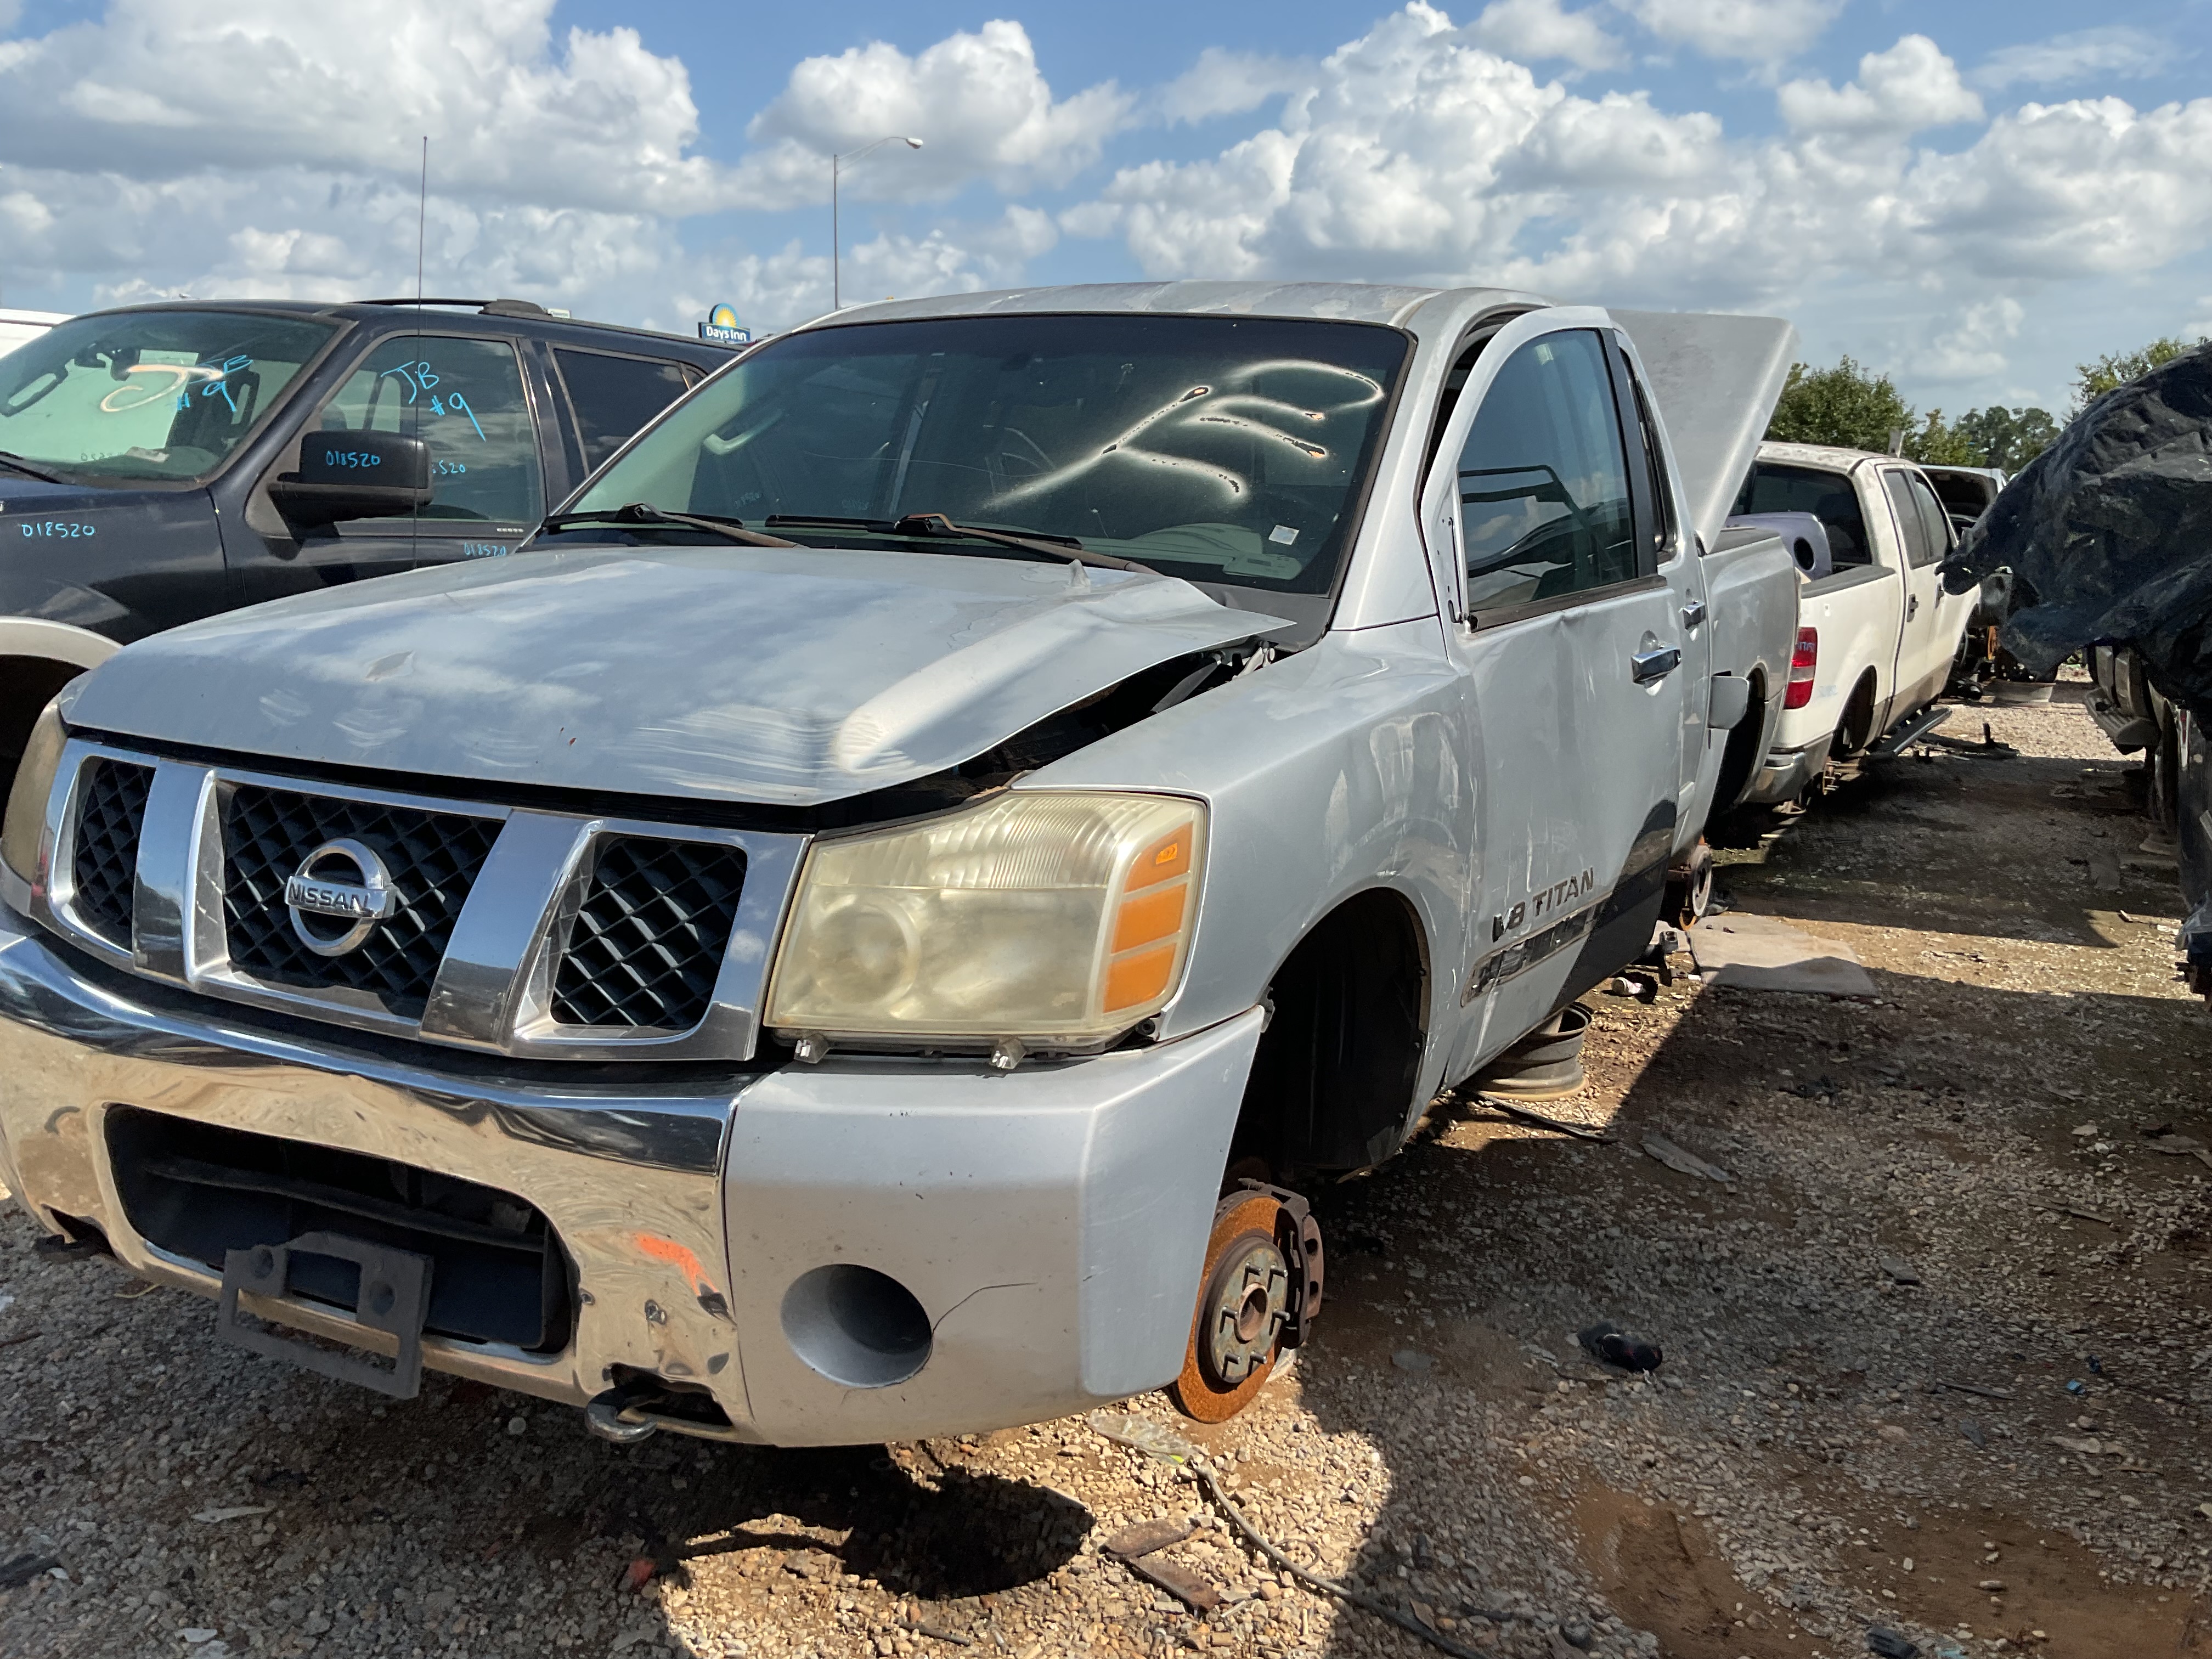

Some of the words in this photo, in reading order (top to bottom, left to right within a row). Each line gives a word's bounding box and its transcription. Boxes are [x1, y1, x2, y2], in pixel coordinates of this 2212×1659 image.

[706, 325, 730, 339] Days
[730, 329, 747, 341] Inn
[380, 361, 439, 404] JB
[429, 392, 487, 443] #9
[325, 450, 382, 469] 018520
[21, 521, 96, 538] 018520
[288, 882, 370, 911] NISSAN
[1532, 866, 1594, 917] TITAN
